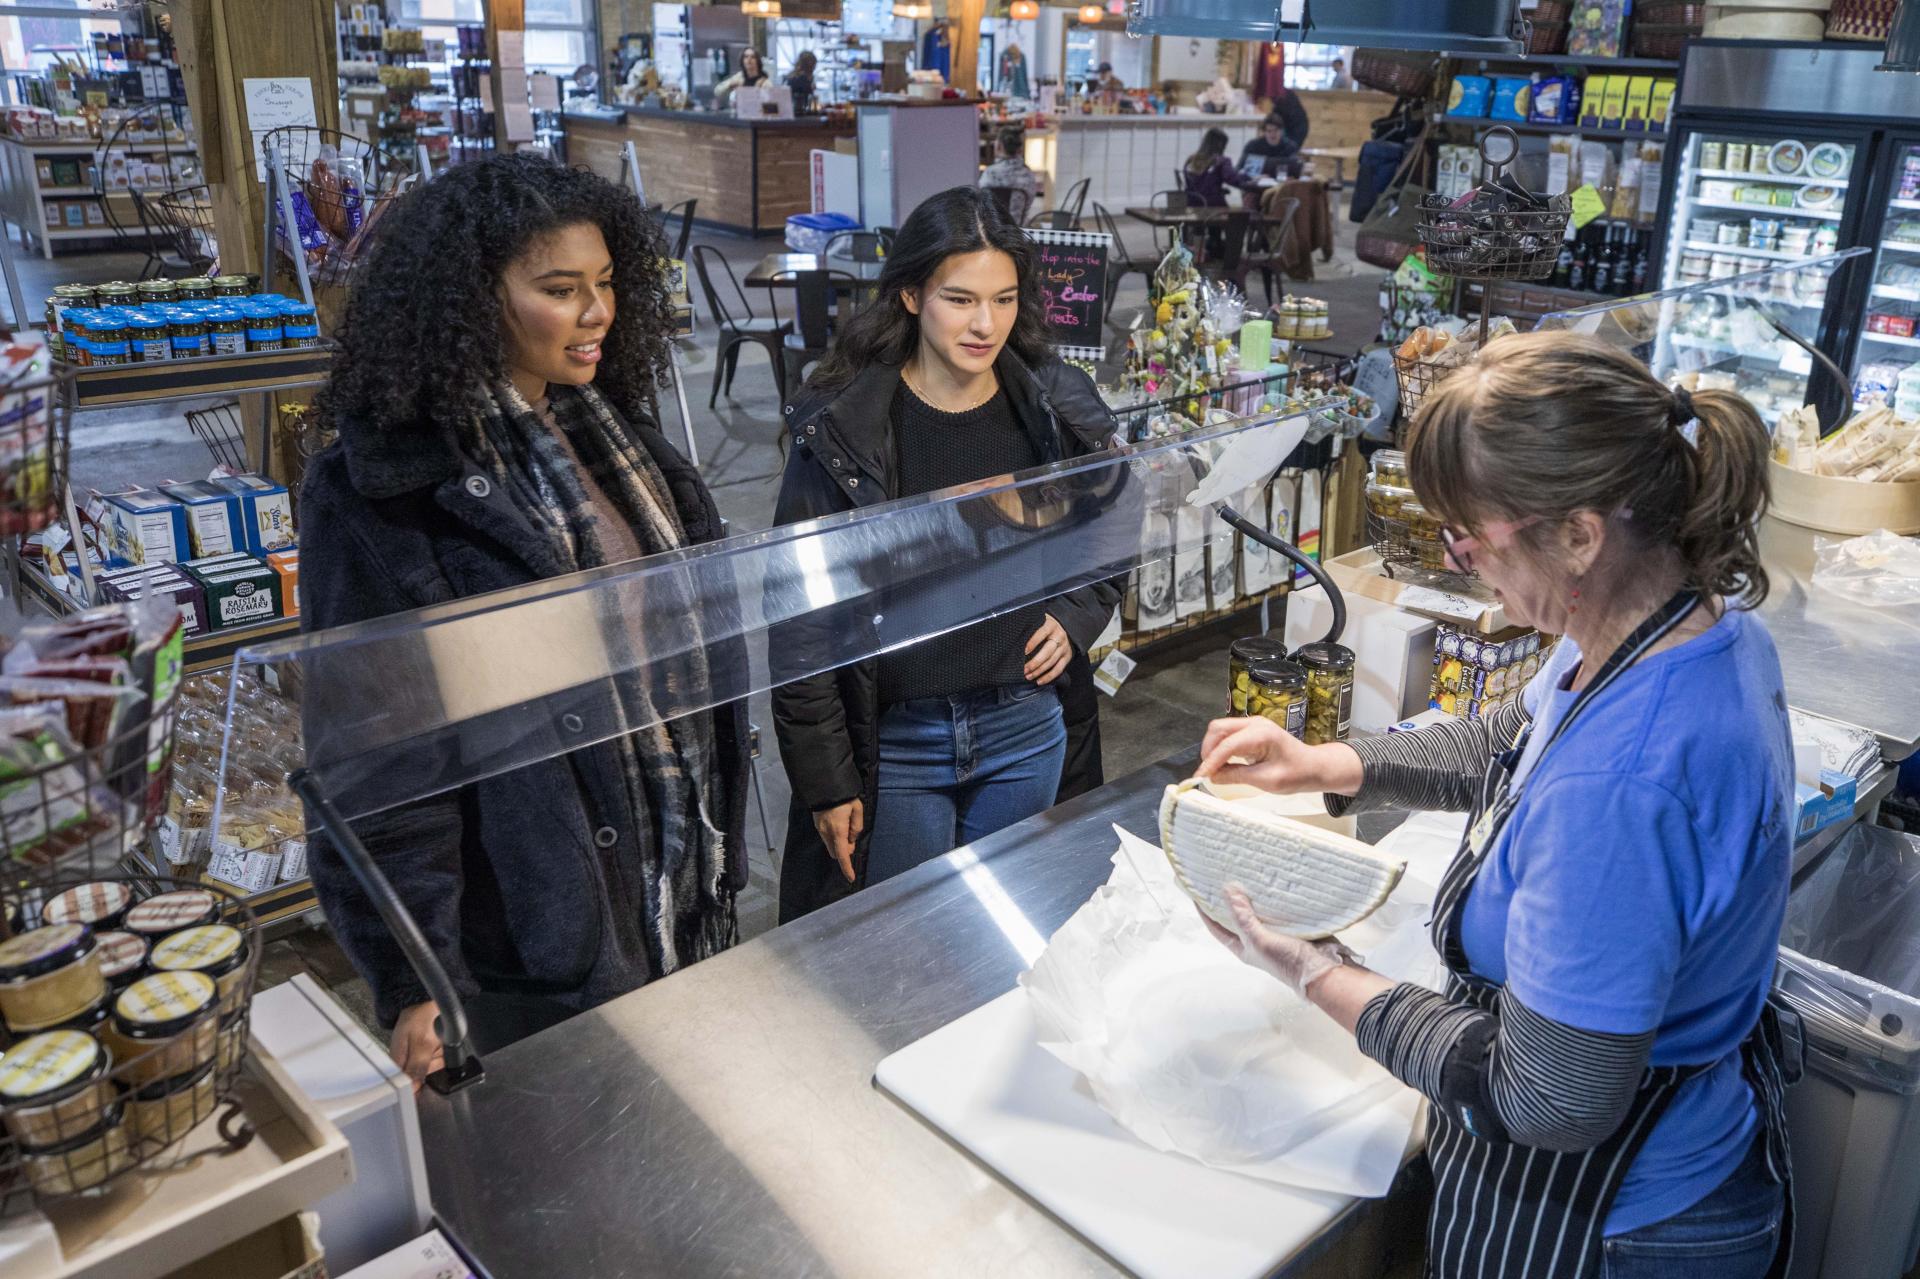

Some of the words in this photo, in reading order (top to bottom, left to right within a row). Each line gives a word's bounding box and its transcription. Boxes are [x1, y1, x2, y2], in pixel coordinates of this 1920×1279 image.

[1041, 246, 1059, 266] Hop
[1064, 251, 1084, 263] into
[1084, 252, 1101, 266] the
[1061, 285, 1099, 302] Easter
[225, 601, 268, 615] ROSEMARY
[227, 597, 257, 608] RAISIN
